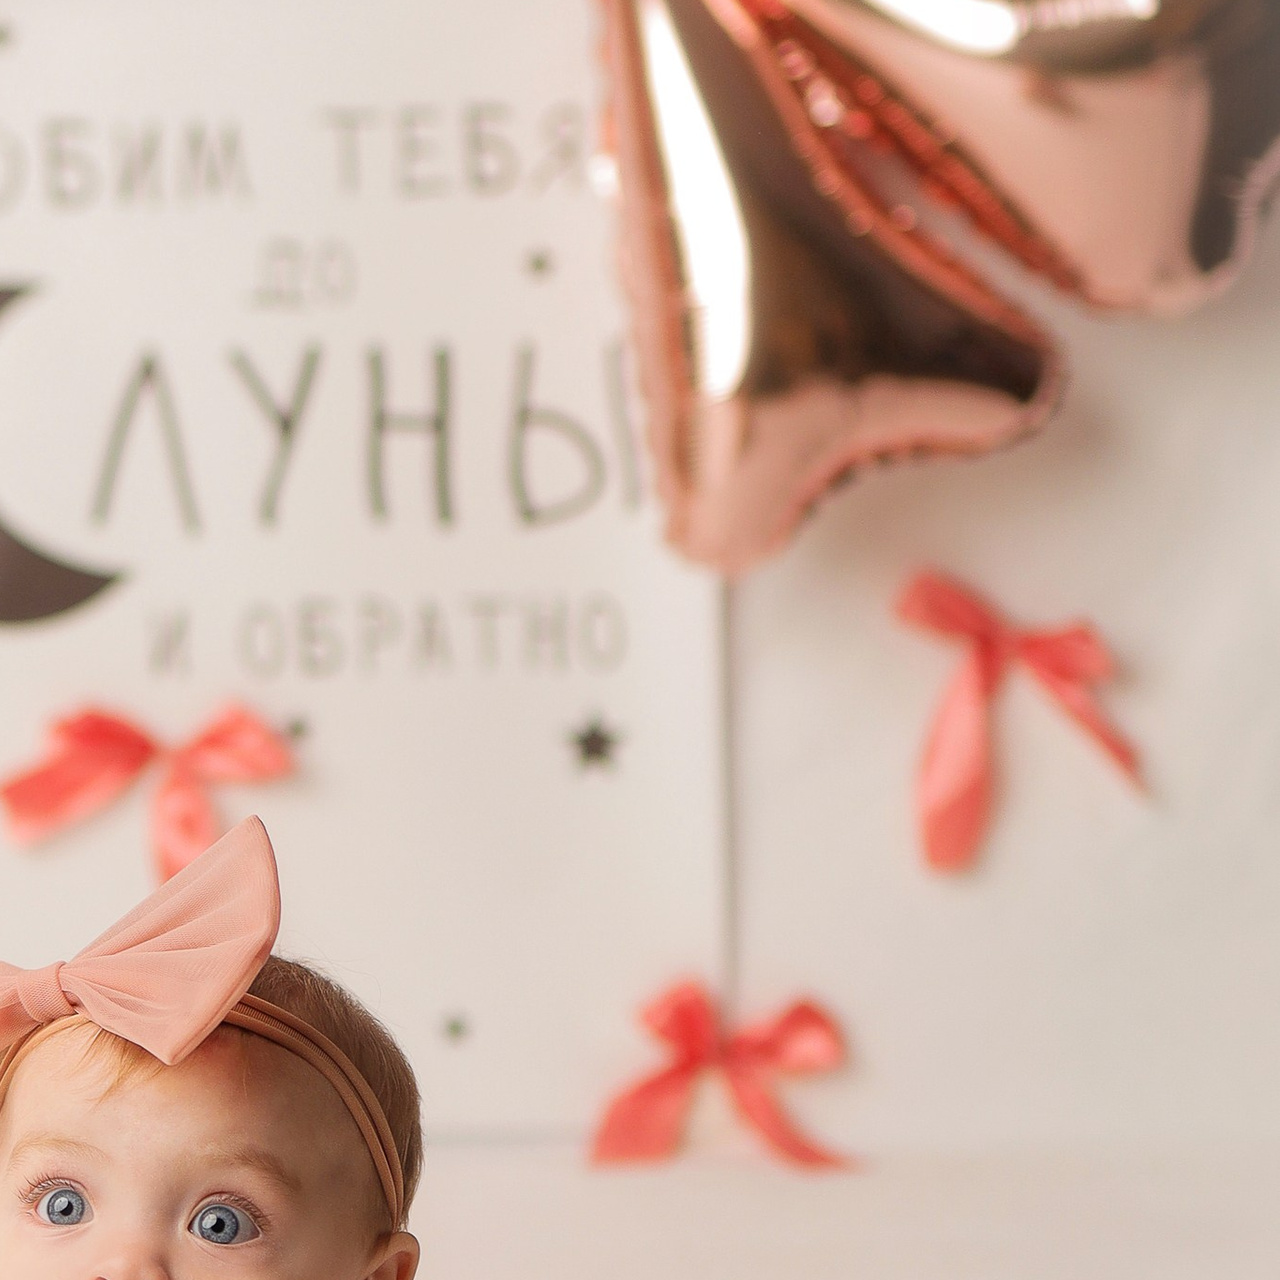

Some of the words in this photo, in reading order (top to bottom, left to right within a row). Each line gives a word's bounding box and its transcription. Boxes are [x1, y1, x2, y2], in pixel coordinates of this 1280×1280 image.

[324, 102, 590, 200] ТЕБЯ
[250, 240, 360, 310] ДО
[89, 338, 644, 532] ЛУНЫ
[148, 608, 194, 677] И
[239, 595, 630, 677] ОБРАТНО
